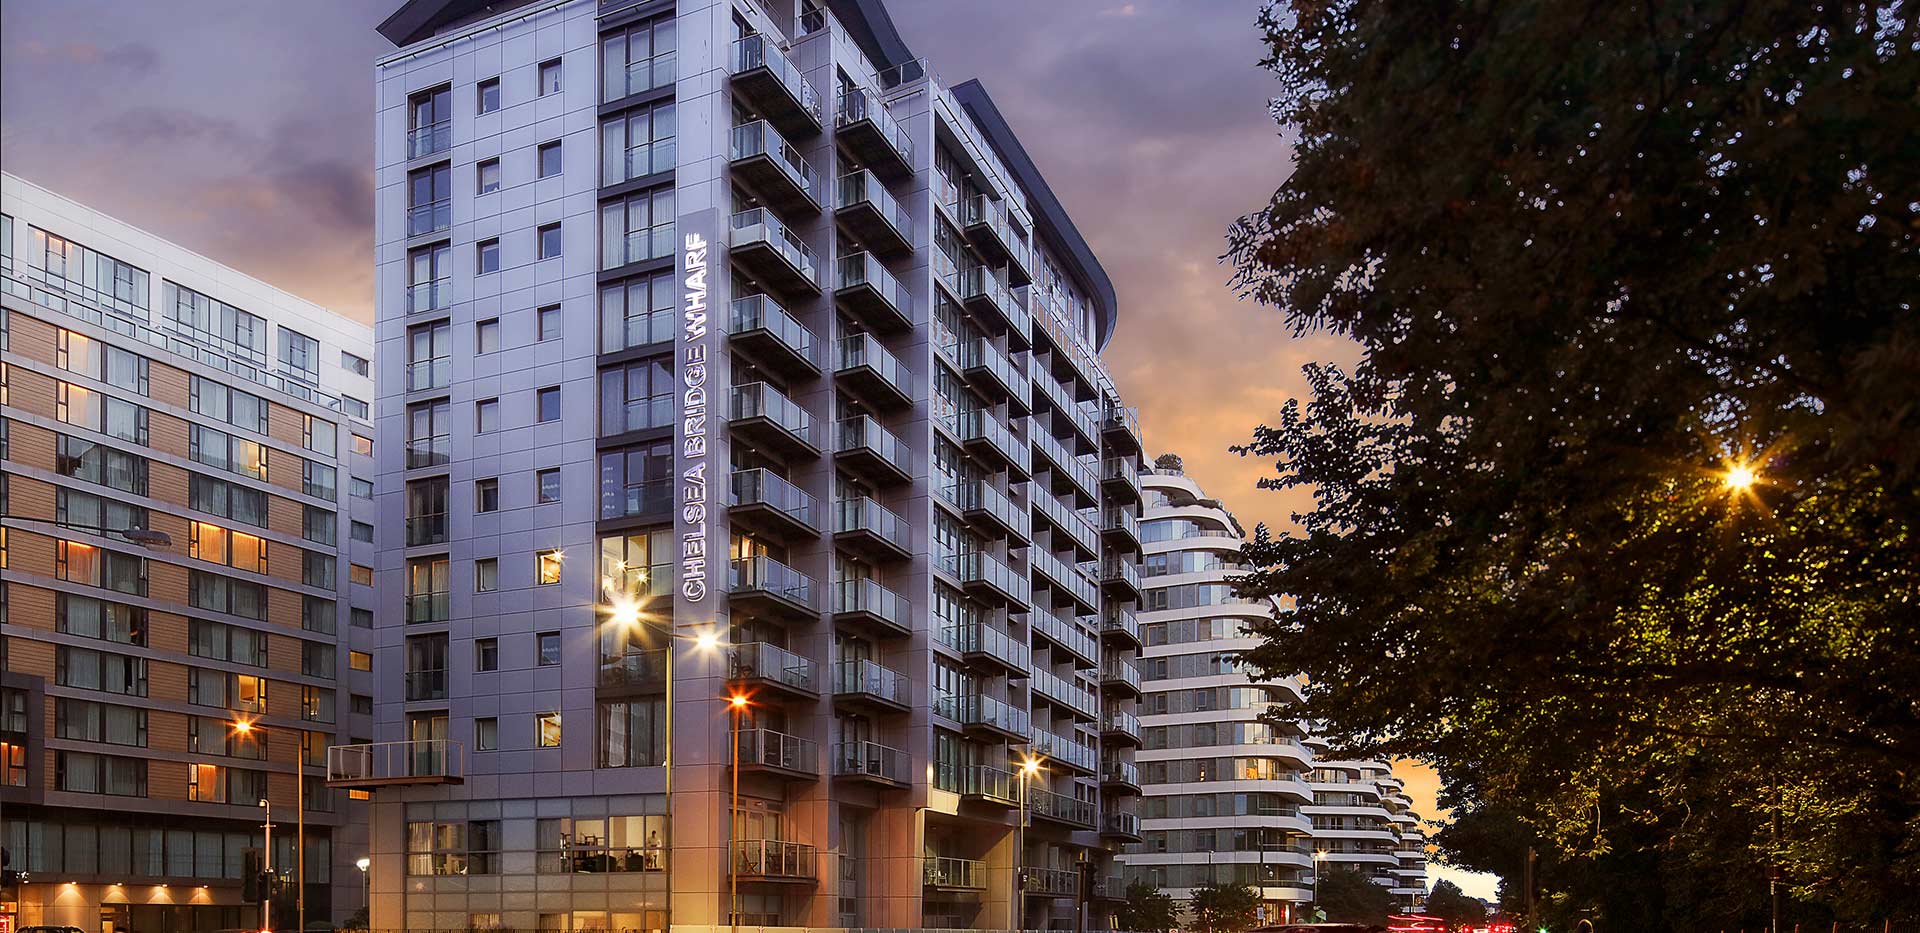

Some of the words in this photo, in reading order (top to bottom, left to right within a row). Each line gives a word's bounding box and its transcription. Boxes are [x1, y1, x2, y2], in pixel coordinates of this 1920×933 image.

[684, 232, 707, 342] WHARF
[684, 344, 707, 459] BRIDGE
[683, 461, 706, 602] CHELSEA
